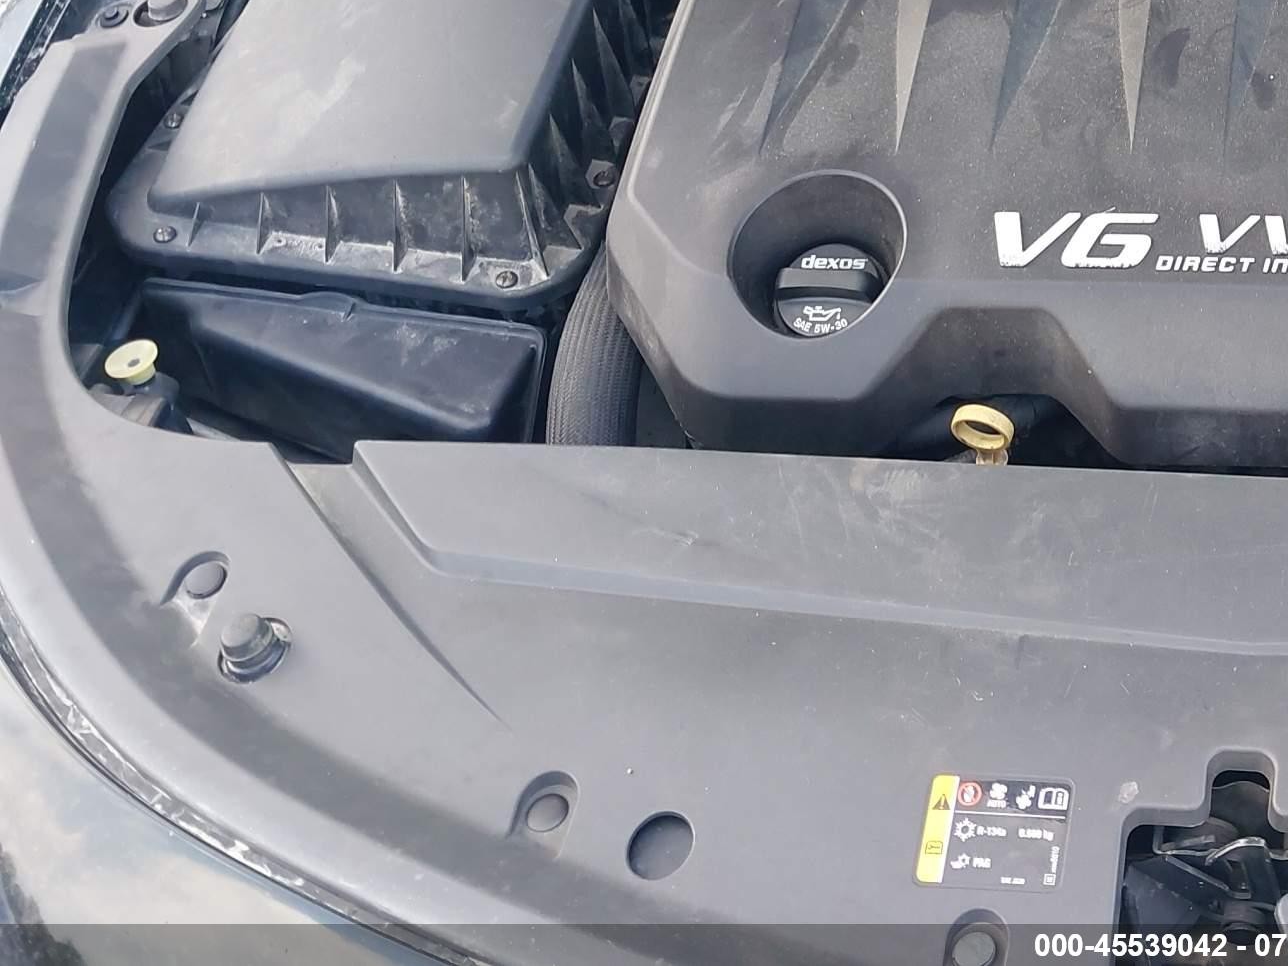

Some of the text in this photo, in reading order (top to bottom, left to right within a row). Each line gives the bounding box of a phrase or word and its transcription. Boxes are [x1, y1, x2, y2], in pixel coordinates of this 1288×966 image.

[993, 211, 1159, 268] V6
[801, 254, 868, 270] dexos
[1155, 255, 1256, 274] DIRECT
[793, 317, 848, 334] SAE 5W-30
